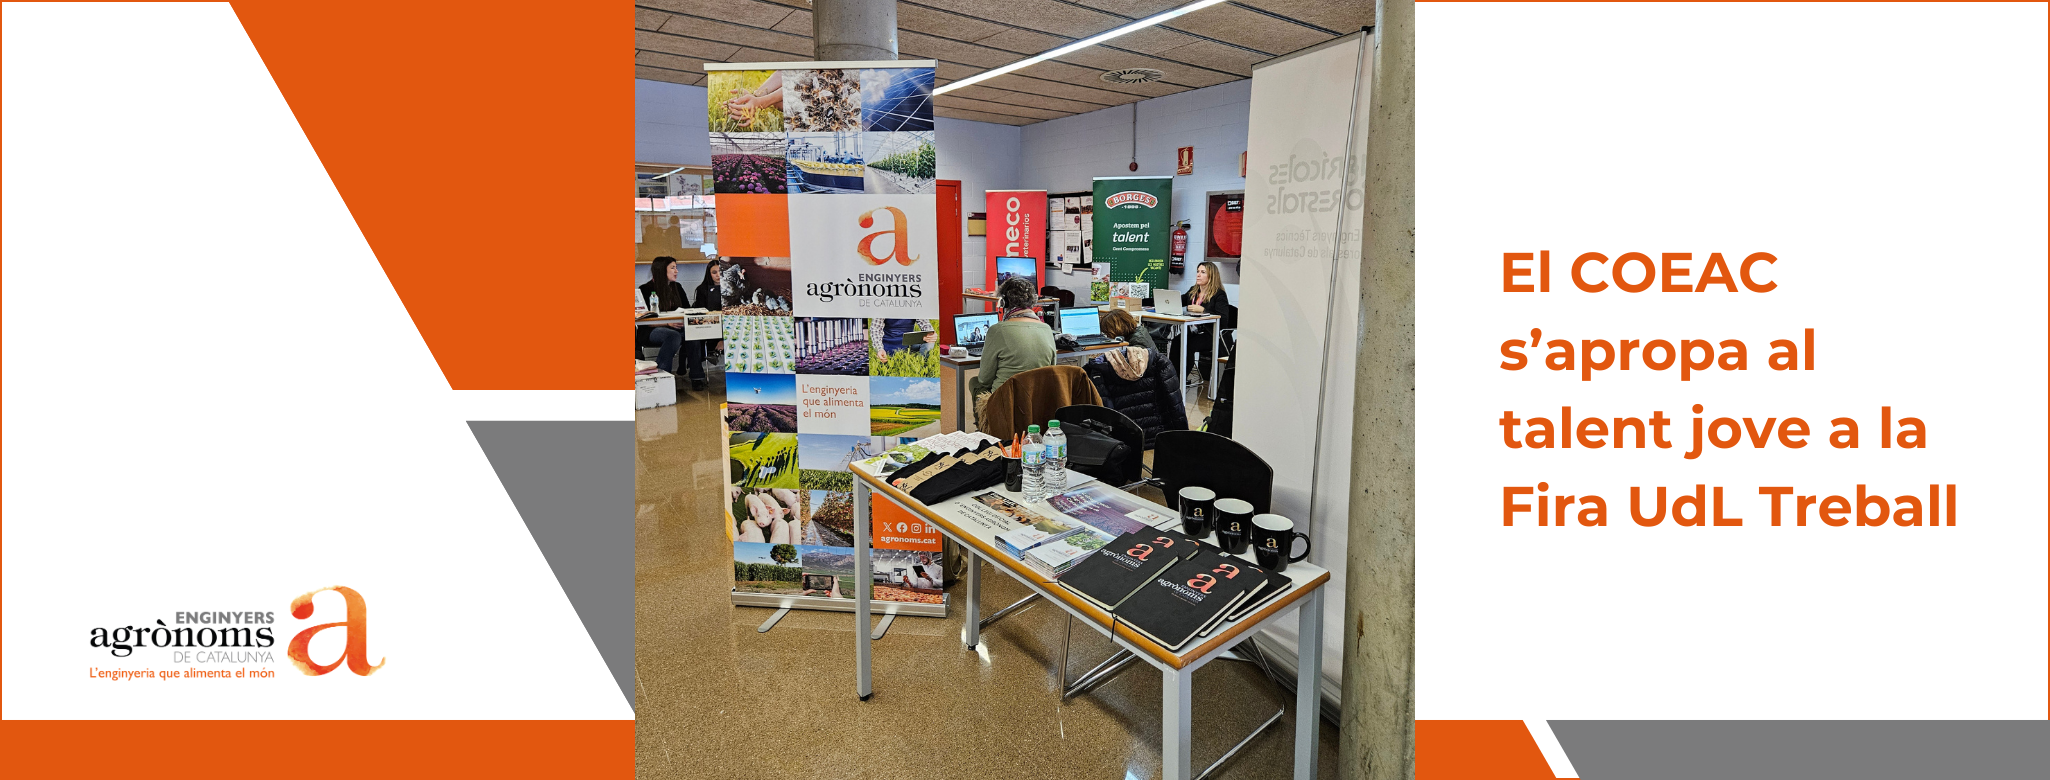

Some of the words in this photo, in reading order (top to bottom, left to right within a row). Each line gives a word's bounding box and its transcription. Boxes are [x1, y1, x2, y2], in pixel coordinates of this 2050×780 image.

[1112, 193, 1151, 204] BORGES
[857, 206, 920, 266] a
[1112, 231, 1150, 243] talent
[858, 274, 922, 283] ENGINYERS
[806, 278, 922, 303] agrònoms
[859, 299, 871, 308] DE
[874, 299, 923, 308] CATALUNYA
[802, 398, 821, 407] que
[823, 397, 864, 407] alimenta
[803, 409, 811, 418] el
[814, 409, 837, 419] món
[880, 536, 936, 545] agronoms.cat
[1100, 548, 1141, 568] agrònoms
[1157, 578, 1204, 602] agrònoms
